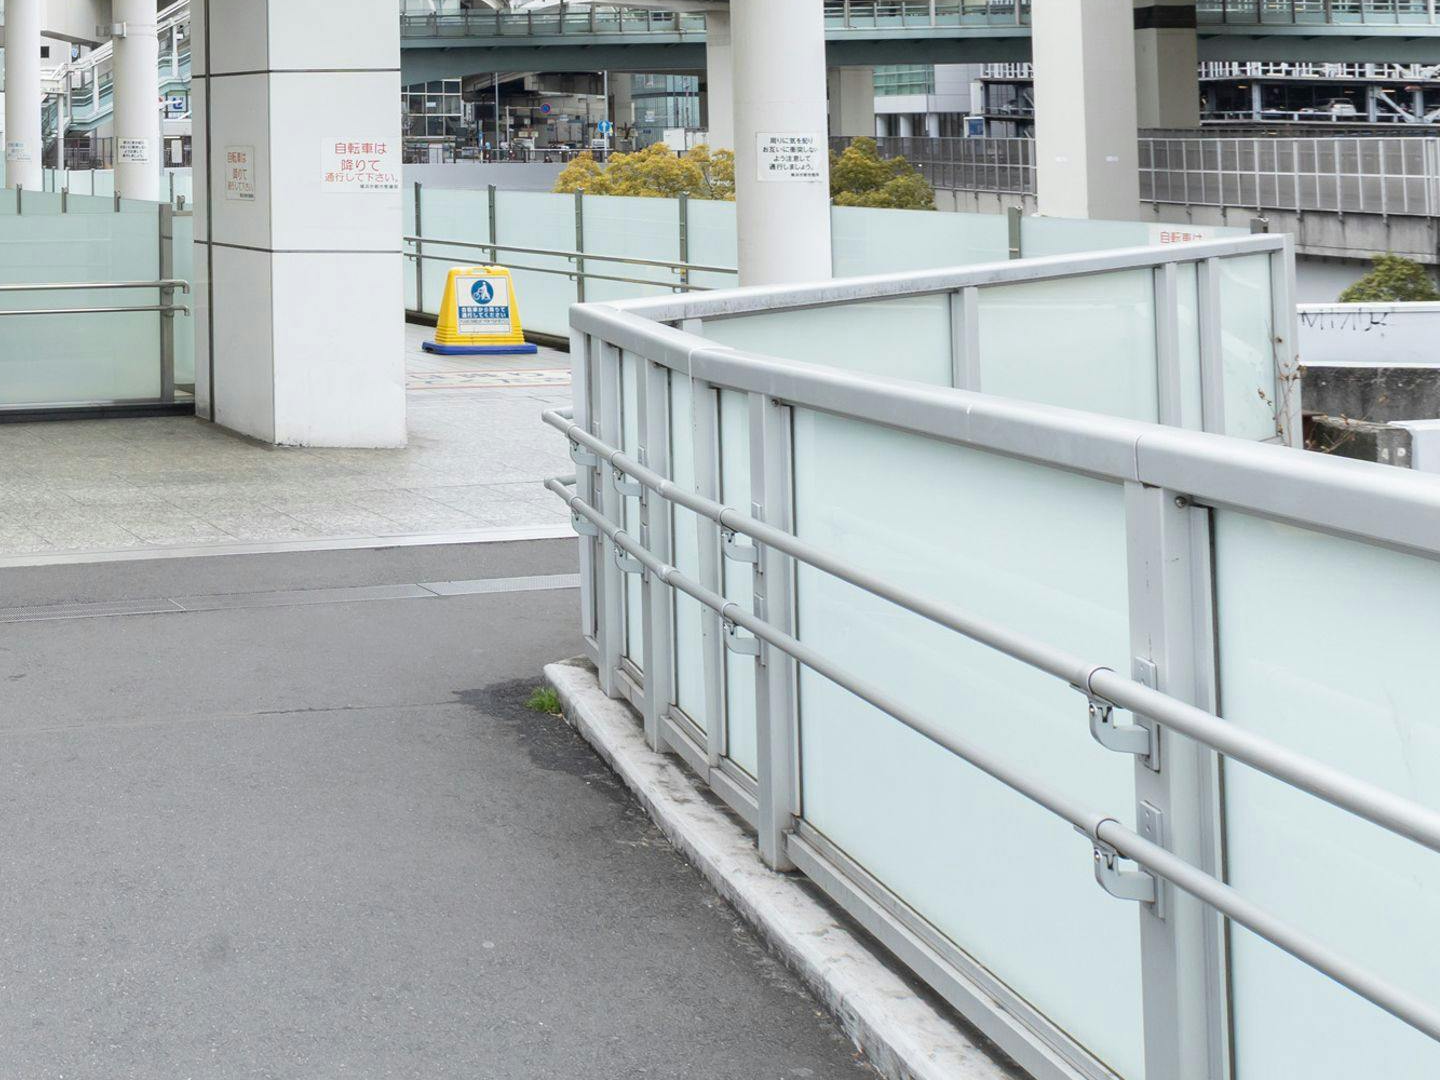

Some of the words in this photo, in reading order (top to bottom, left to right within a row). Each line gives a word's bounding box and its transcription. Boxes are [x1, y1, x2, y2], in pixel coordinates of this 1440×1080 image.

[335, 142, 387, 155] 自転車は
[341, 159, 380, 172] 降りて
